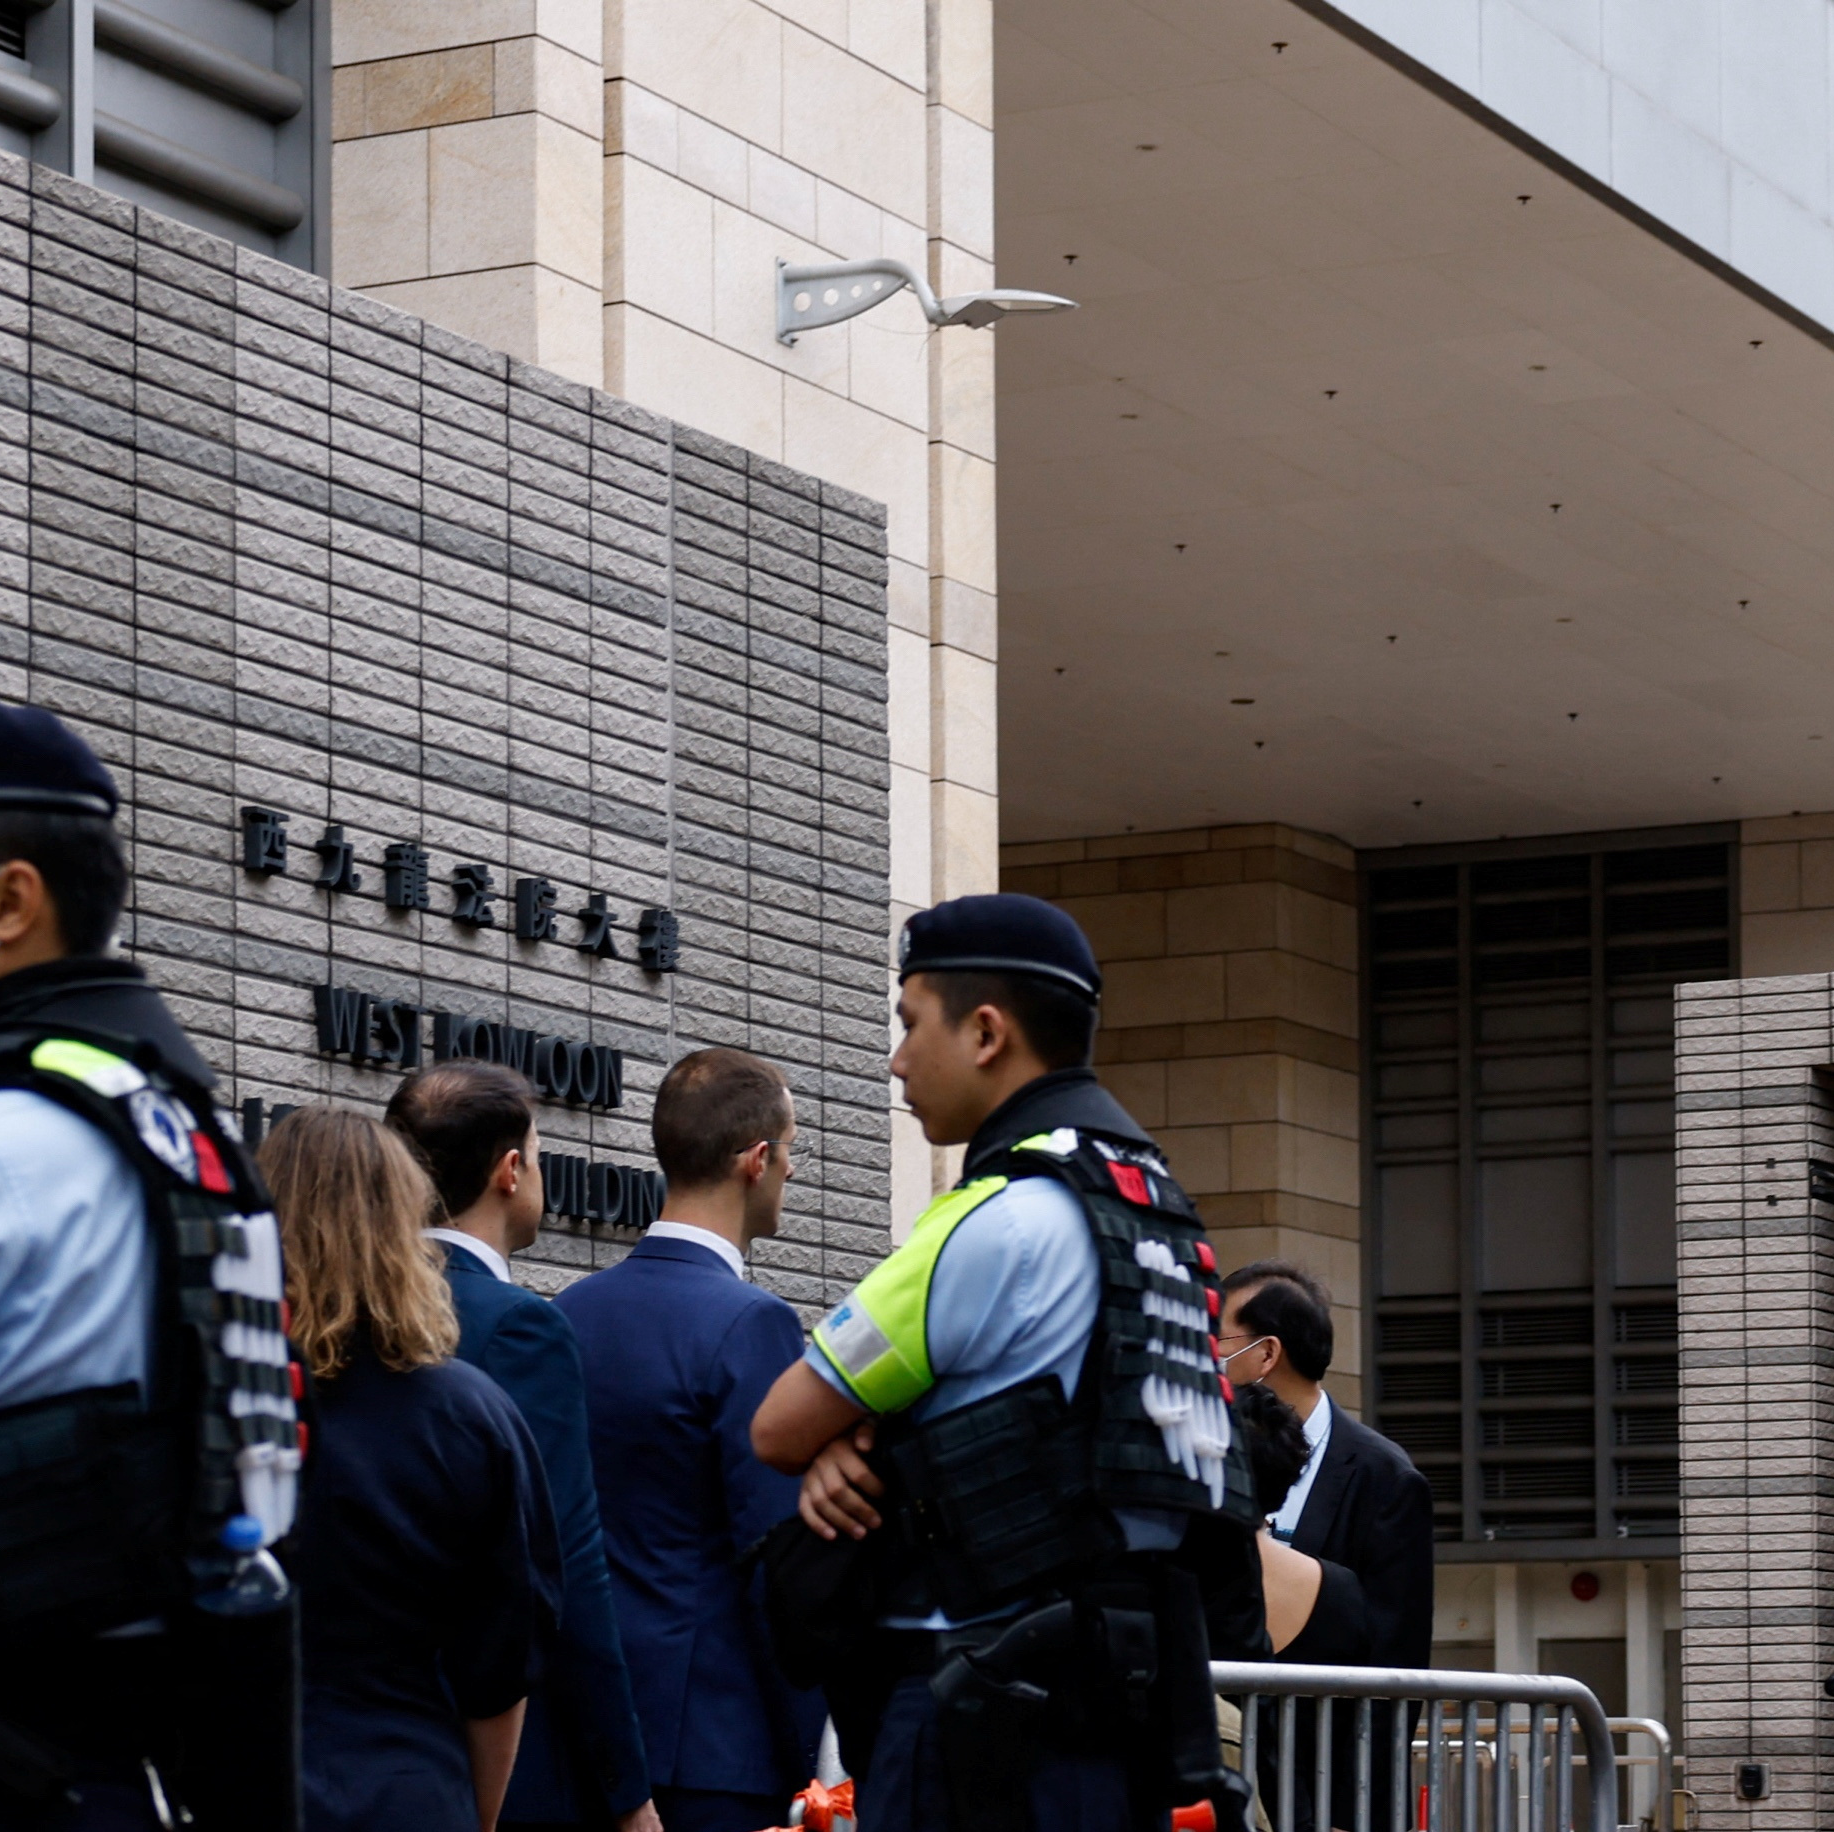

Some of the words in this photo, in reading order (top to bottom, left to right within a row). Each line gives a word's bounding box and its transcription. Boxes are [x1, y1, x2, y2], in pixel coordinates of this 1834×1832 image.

[241, 805, 681, 974] 西九龍法院大樓
[314, 984, 429, 1068] WEST
[433, 1012, 624, 1110] KOWLOON
[540, 1151, 668, 1230] UILDIN
